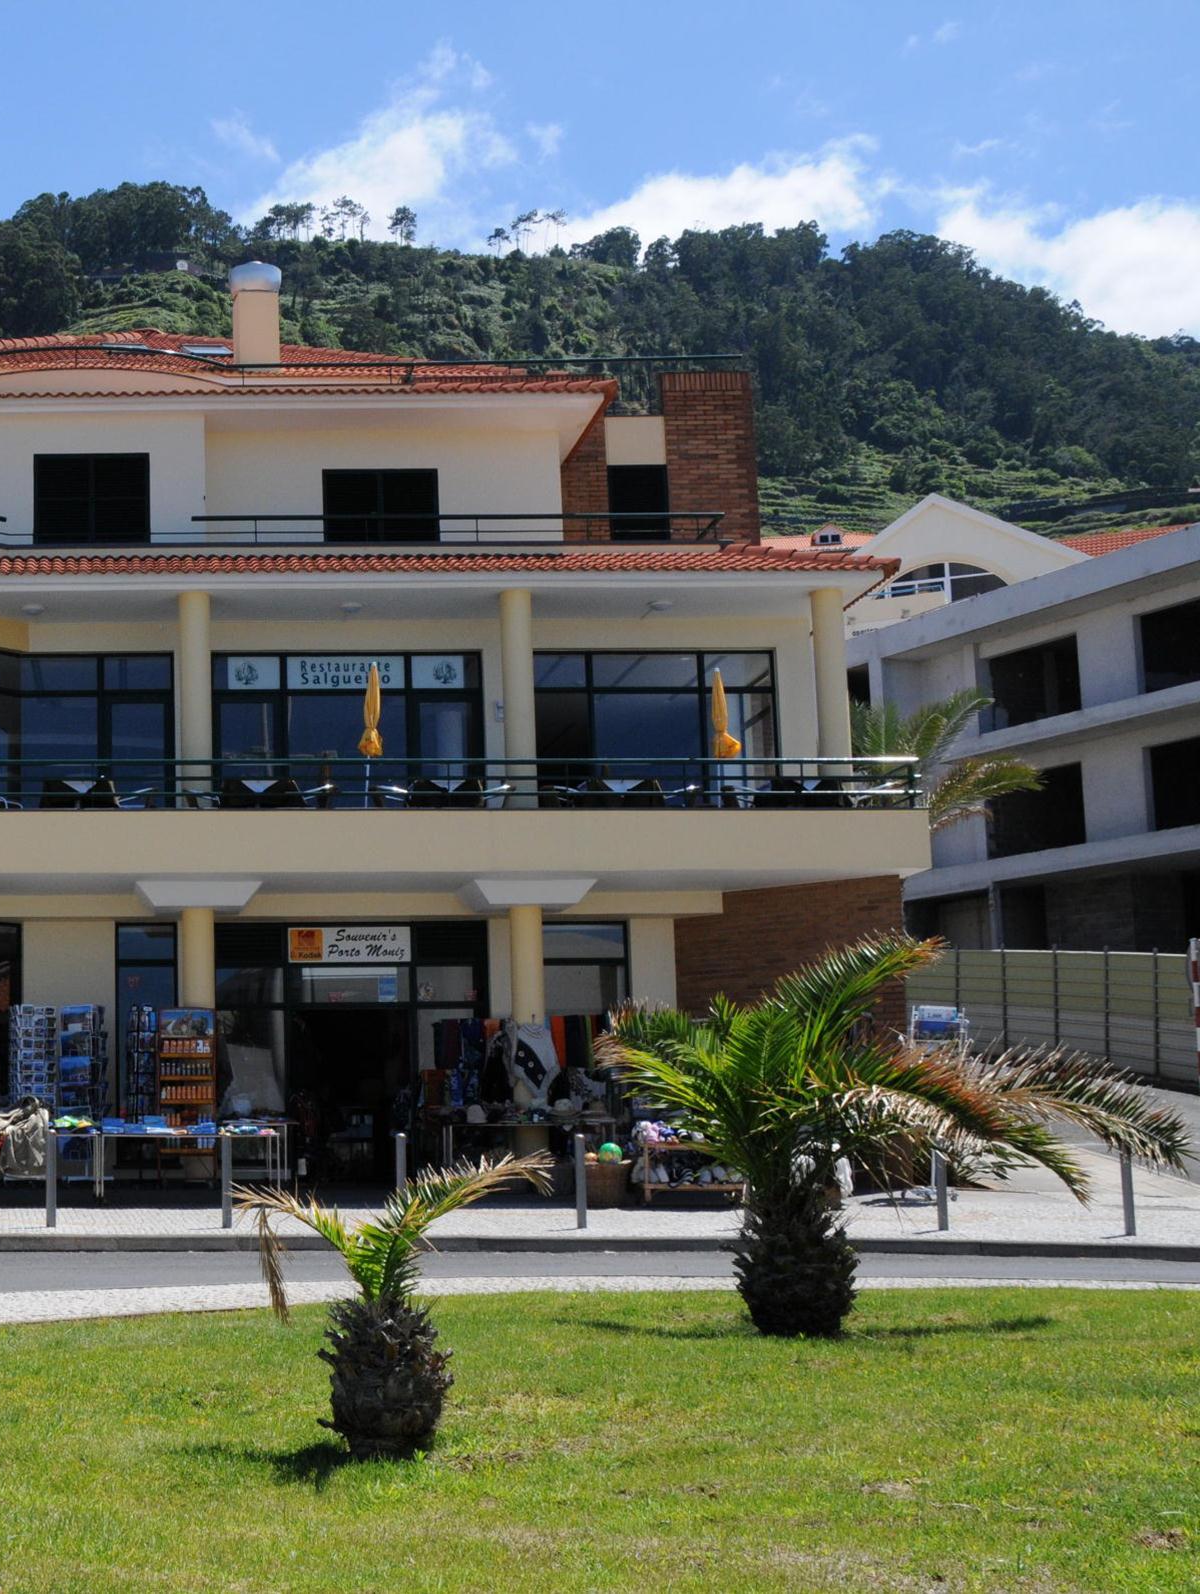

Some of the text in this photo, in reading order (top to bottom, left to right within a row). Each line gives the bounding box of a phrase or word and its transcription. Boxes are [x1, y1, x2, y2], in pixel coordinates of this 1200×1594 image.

[301, 672, 390, 687] Salgueio
[335, 928, 397, 942] Souvenir's
[328, 943, 405, 960] Porto Moniz
